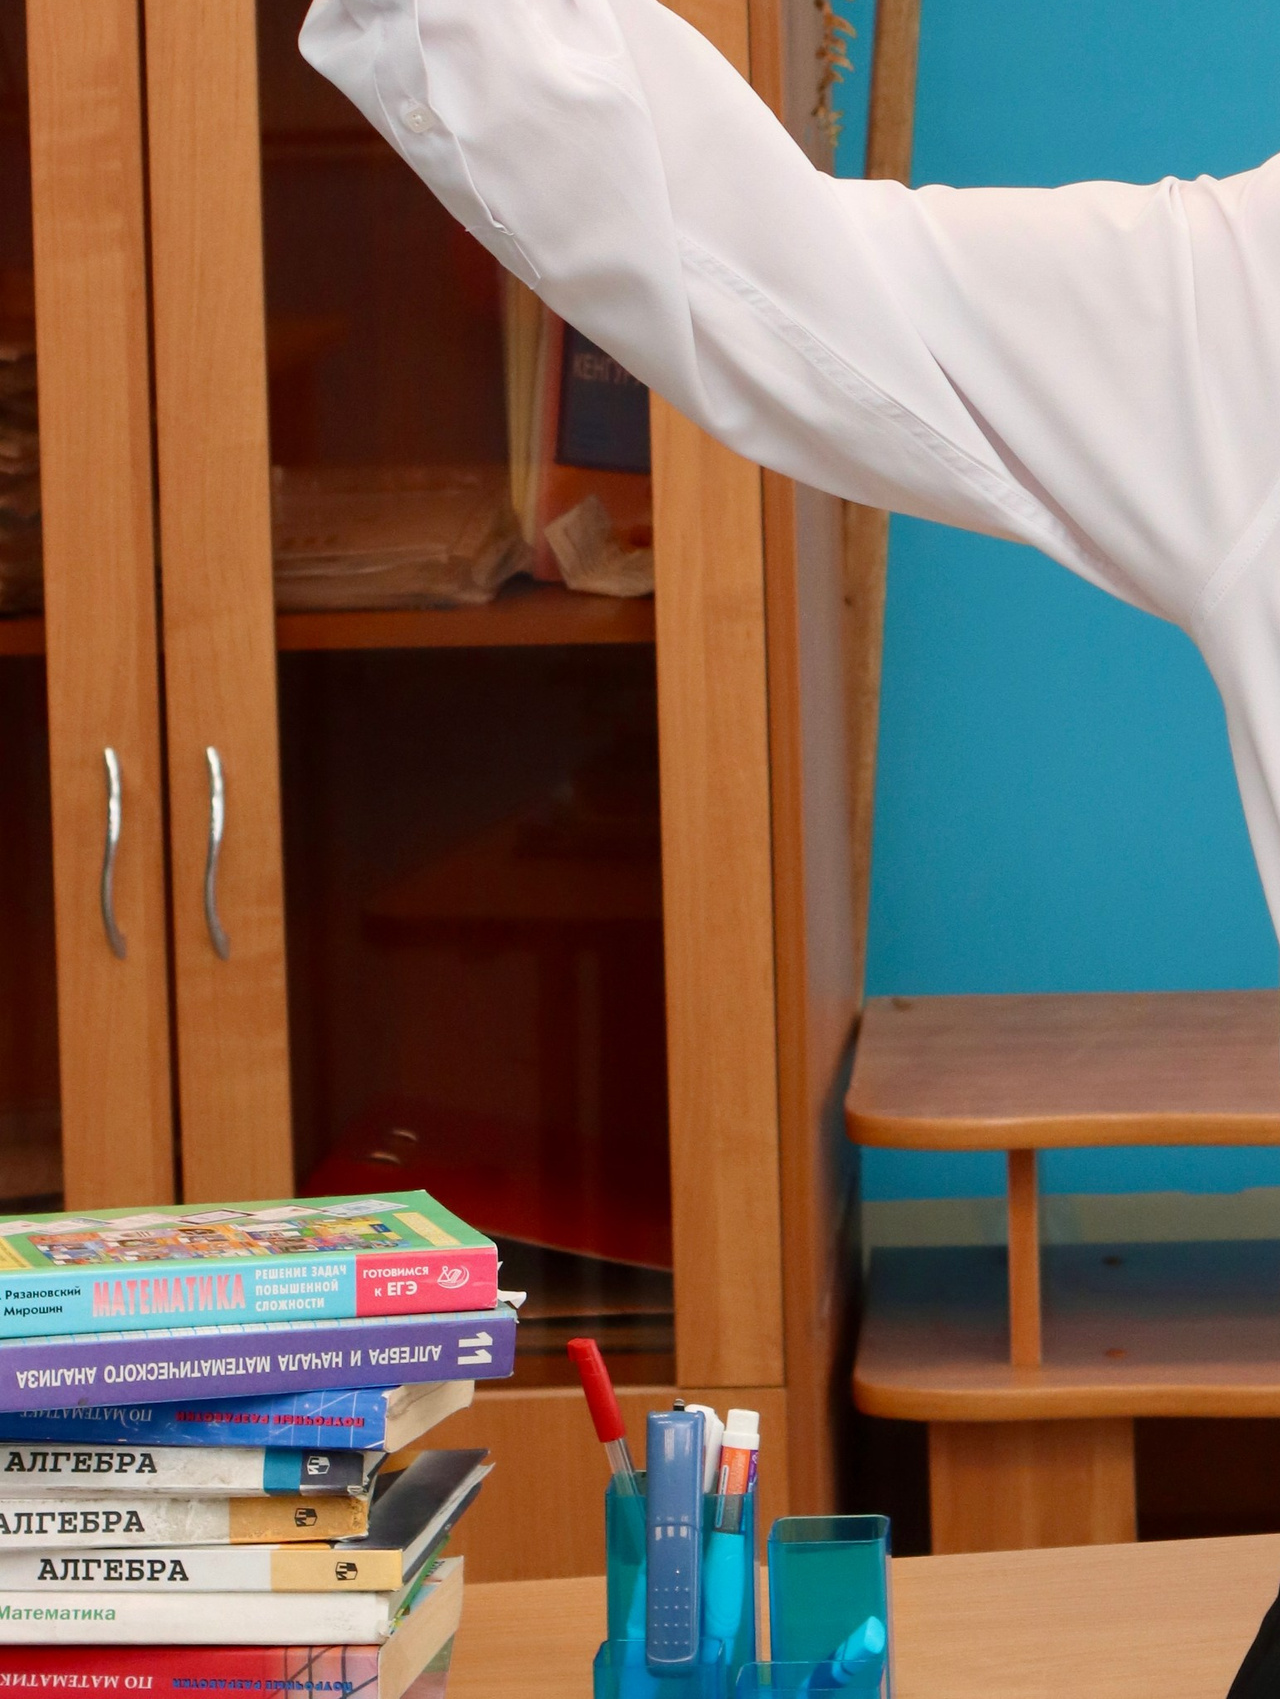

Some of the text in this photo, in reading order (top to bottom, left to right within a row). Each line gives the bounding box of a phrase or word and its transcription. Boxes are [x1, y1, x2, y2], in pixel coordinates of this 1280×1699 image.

[254, 1264, 347, 1281] РЕШЕНИЕ ЗАДАЧ
[362, 1265, 429, 1279] ГОТОВИМСЯ
[4, 1285, 81, 1301] Рязановский
[92, 1273, 246, 1318] МАТЕМАТИКА
[255, 1279, 339, 1296] ПОВЫШЕННОЙ
[387, 1281, 418, 1297] ЕГЭ
[3, 1304, 63, 1319] Мирошин
[255, 1297, 325, 1312] СЛОЖНОСТИ
[457, 1331, 494, 1367] 11
[16, 1344, 442, 1389] АЛГЕБРА И НАЧАЛА МАТЕМАТИЧЕСКОГО АНАЛИЗА
[128, 1407, 153, 1422] ПО
[175, 1411, 270, 1427] РАЗРАБОТКИ
[273, 1413, 365, 1428] ПОУРОЧНЫЕ
[4, 1451, 158, 1474] АЛГЕБРА
[37, 1558, 190, 1582] АЛГЕБРА
[0, 1604, 117, 1621] Математика
[124, 1676, 153, 1690] ПО
[172, 1677, 261, 1691] РАЗРАБОТКИ
[265, 1679, 353, 1694] ПОУРОЧНЫЕ
